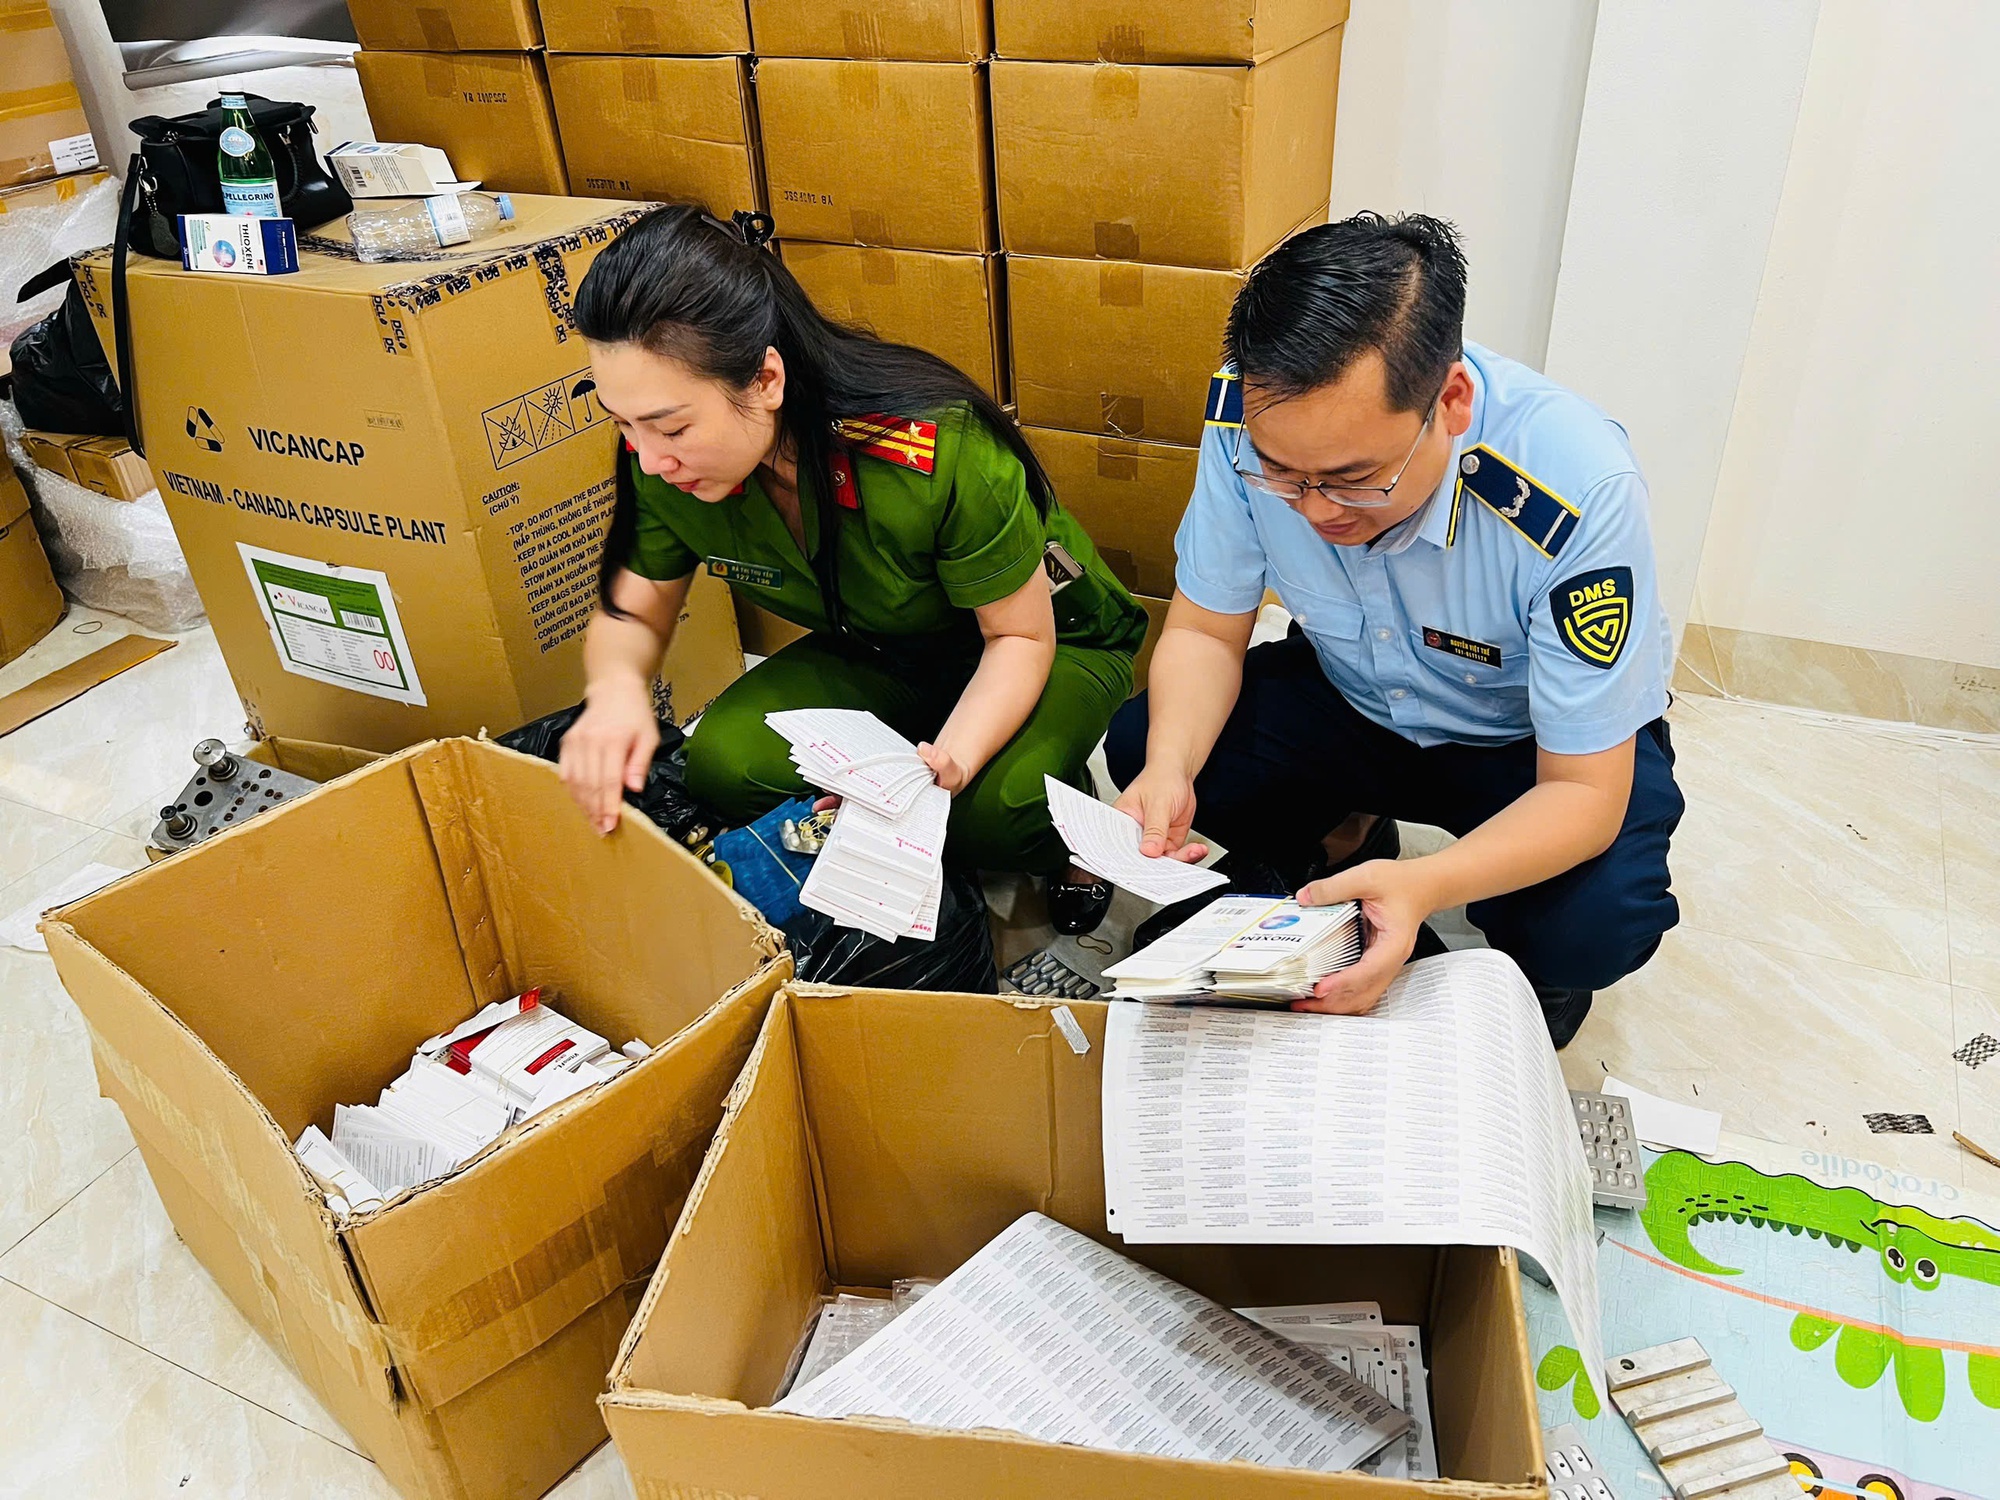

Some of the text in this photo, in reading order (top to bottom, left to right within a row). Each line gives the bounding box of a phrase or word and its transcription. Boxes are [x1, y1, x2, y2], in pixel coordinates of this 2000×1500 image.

[241, 223, 255, 270] THIOXENE
[390, 319, 406, 342] DCL
[247, 426, 365, 466] VICANCAP
[162, 469, 225, 506] VIETNAM
[233, 488, 301, 522] CANADA
[301, 502, 384, 537] CAPSULE
[384, 515, 447, 545] PLANT
[482, 481, 521, 504] CAUTION:
[527, 514, 539, 527] DO
[539, 507, 554, 523] NOT
[554, 500, 573, 515] TURN
[573, 493, 587, 505] THE
[587, 486, 602, 498] BOX
[517, 545, 537, 563] KEEP
[537, 541, 546, 554] IN
[552, 530, 572, 547] COOL
[572, 520, 586, 535] AND
[586, 513, 600, 527] DRY
[524, 573, 545, 589] STOW
[546, 562, 567, 578] AWAY
[567, 551, 586, 567] FROM
[586, 543, 600, 557] THE
[531, 599, 550, 615] KEEP
[551, 588, 571, 604] BAGS
[571, 573, 597, 594] SEALED
[569, 595, 584, 608] BAO
[1568, 578, 1617, 608] DMS
[537, 613, 575, 641] CONDITION
[575, 607, 589, 620] FOR
[373, 649, 395, 672] 00
[1800, 1149, 1960, 1201] crocodile
